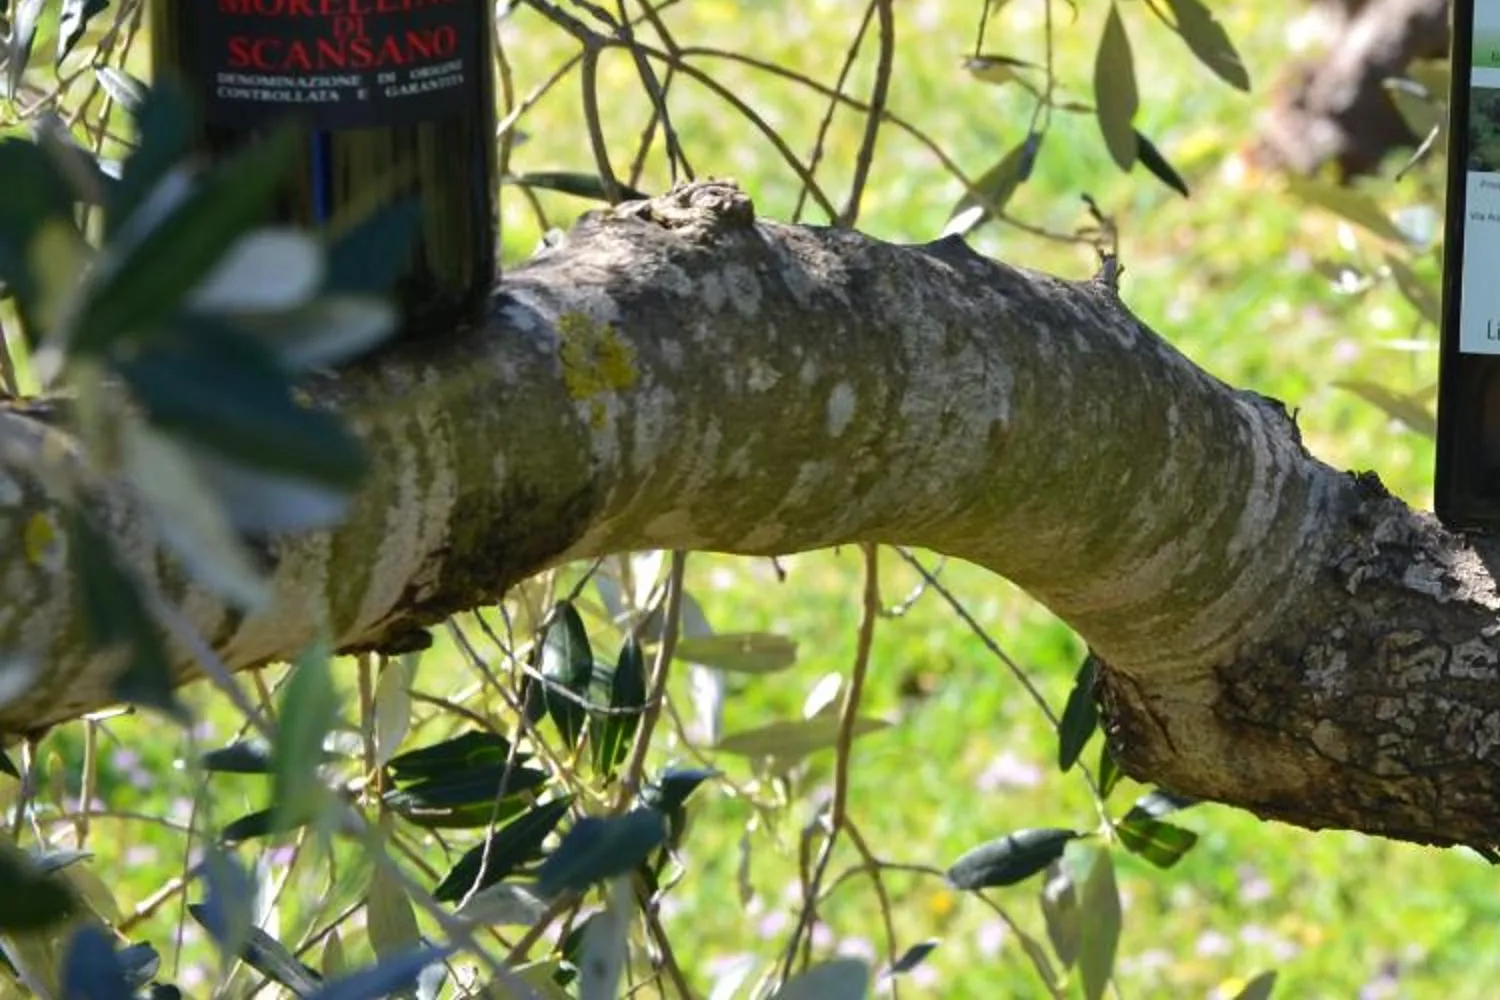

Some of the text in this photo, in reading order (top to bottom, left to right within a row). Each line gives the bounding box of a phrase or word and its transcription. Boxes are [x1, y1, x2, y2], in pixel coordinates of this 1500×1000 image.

[331, 13, 365, 40] DI
[227, 25, 457, 71] SCANSANO
[216, 72, 362, 87] DENOMINAZIONE
[377, 71, 396, 84] DI
[216, 86, 340, 101] CONTROLLATA
[357, 88, 368, 100] E
